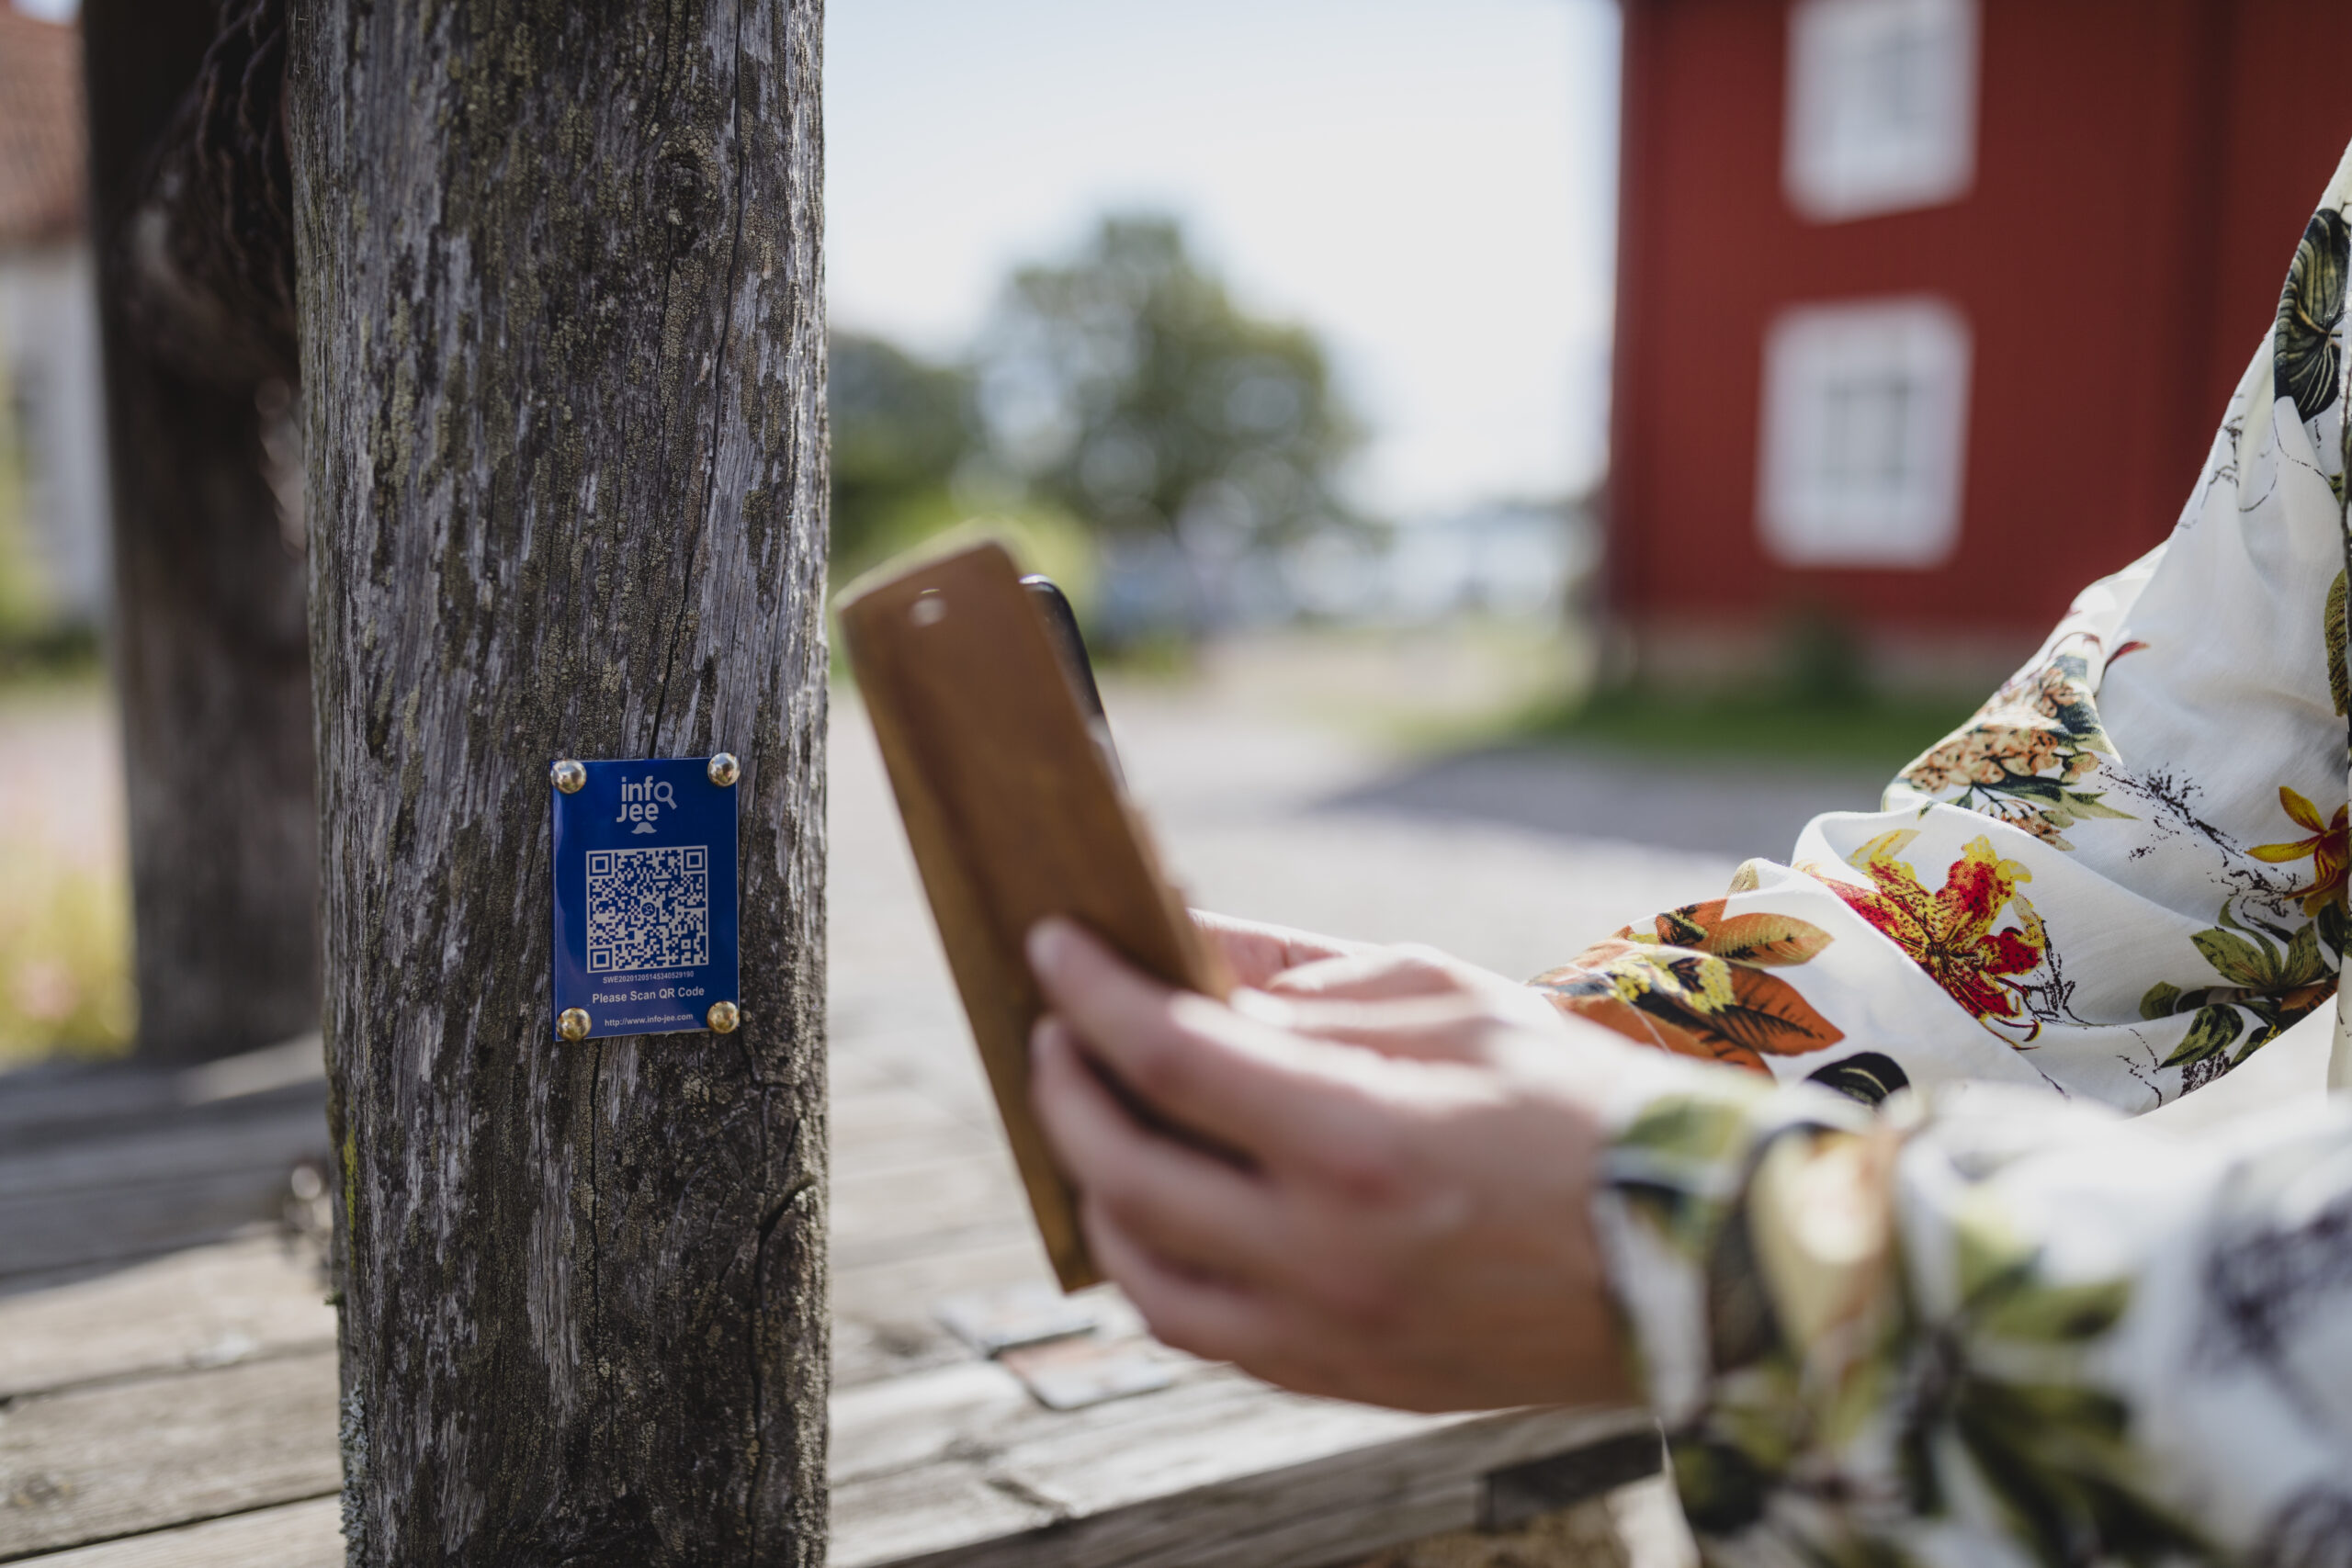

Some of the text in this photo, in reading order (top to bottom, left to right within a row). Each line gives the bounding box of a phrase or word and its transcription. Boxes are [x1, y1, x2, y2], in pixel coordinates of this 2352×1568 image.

[616, 803, 659, 822] jee
[592, 986, 705, 1004] Please Scan QR Code
[605, 1013, 694, 1027] http://www.info-jee.com
